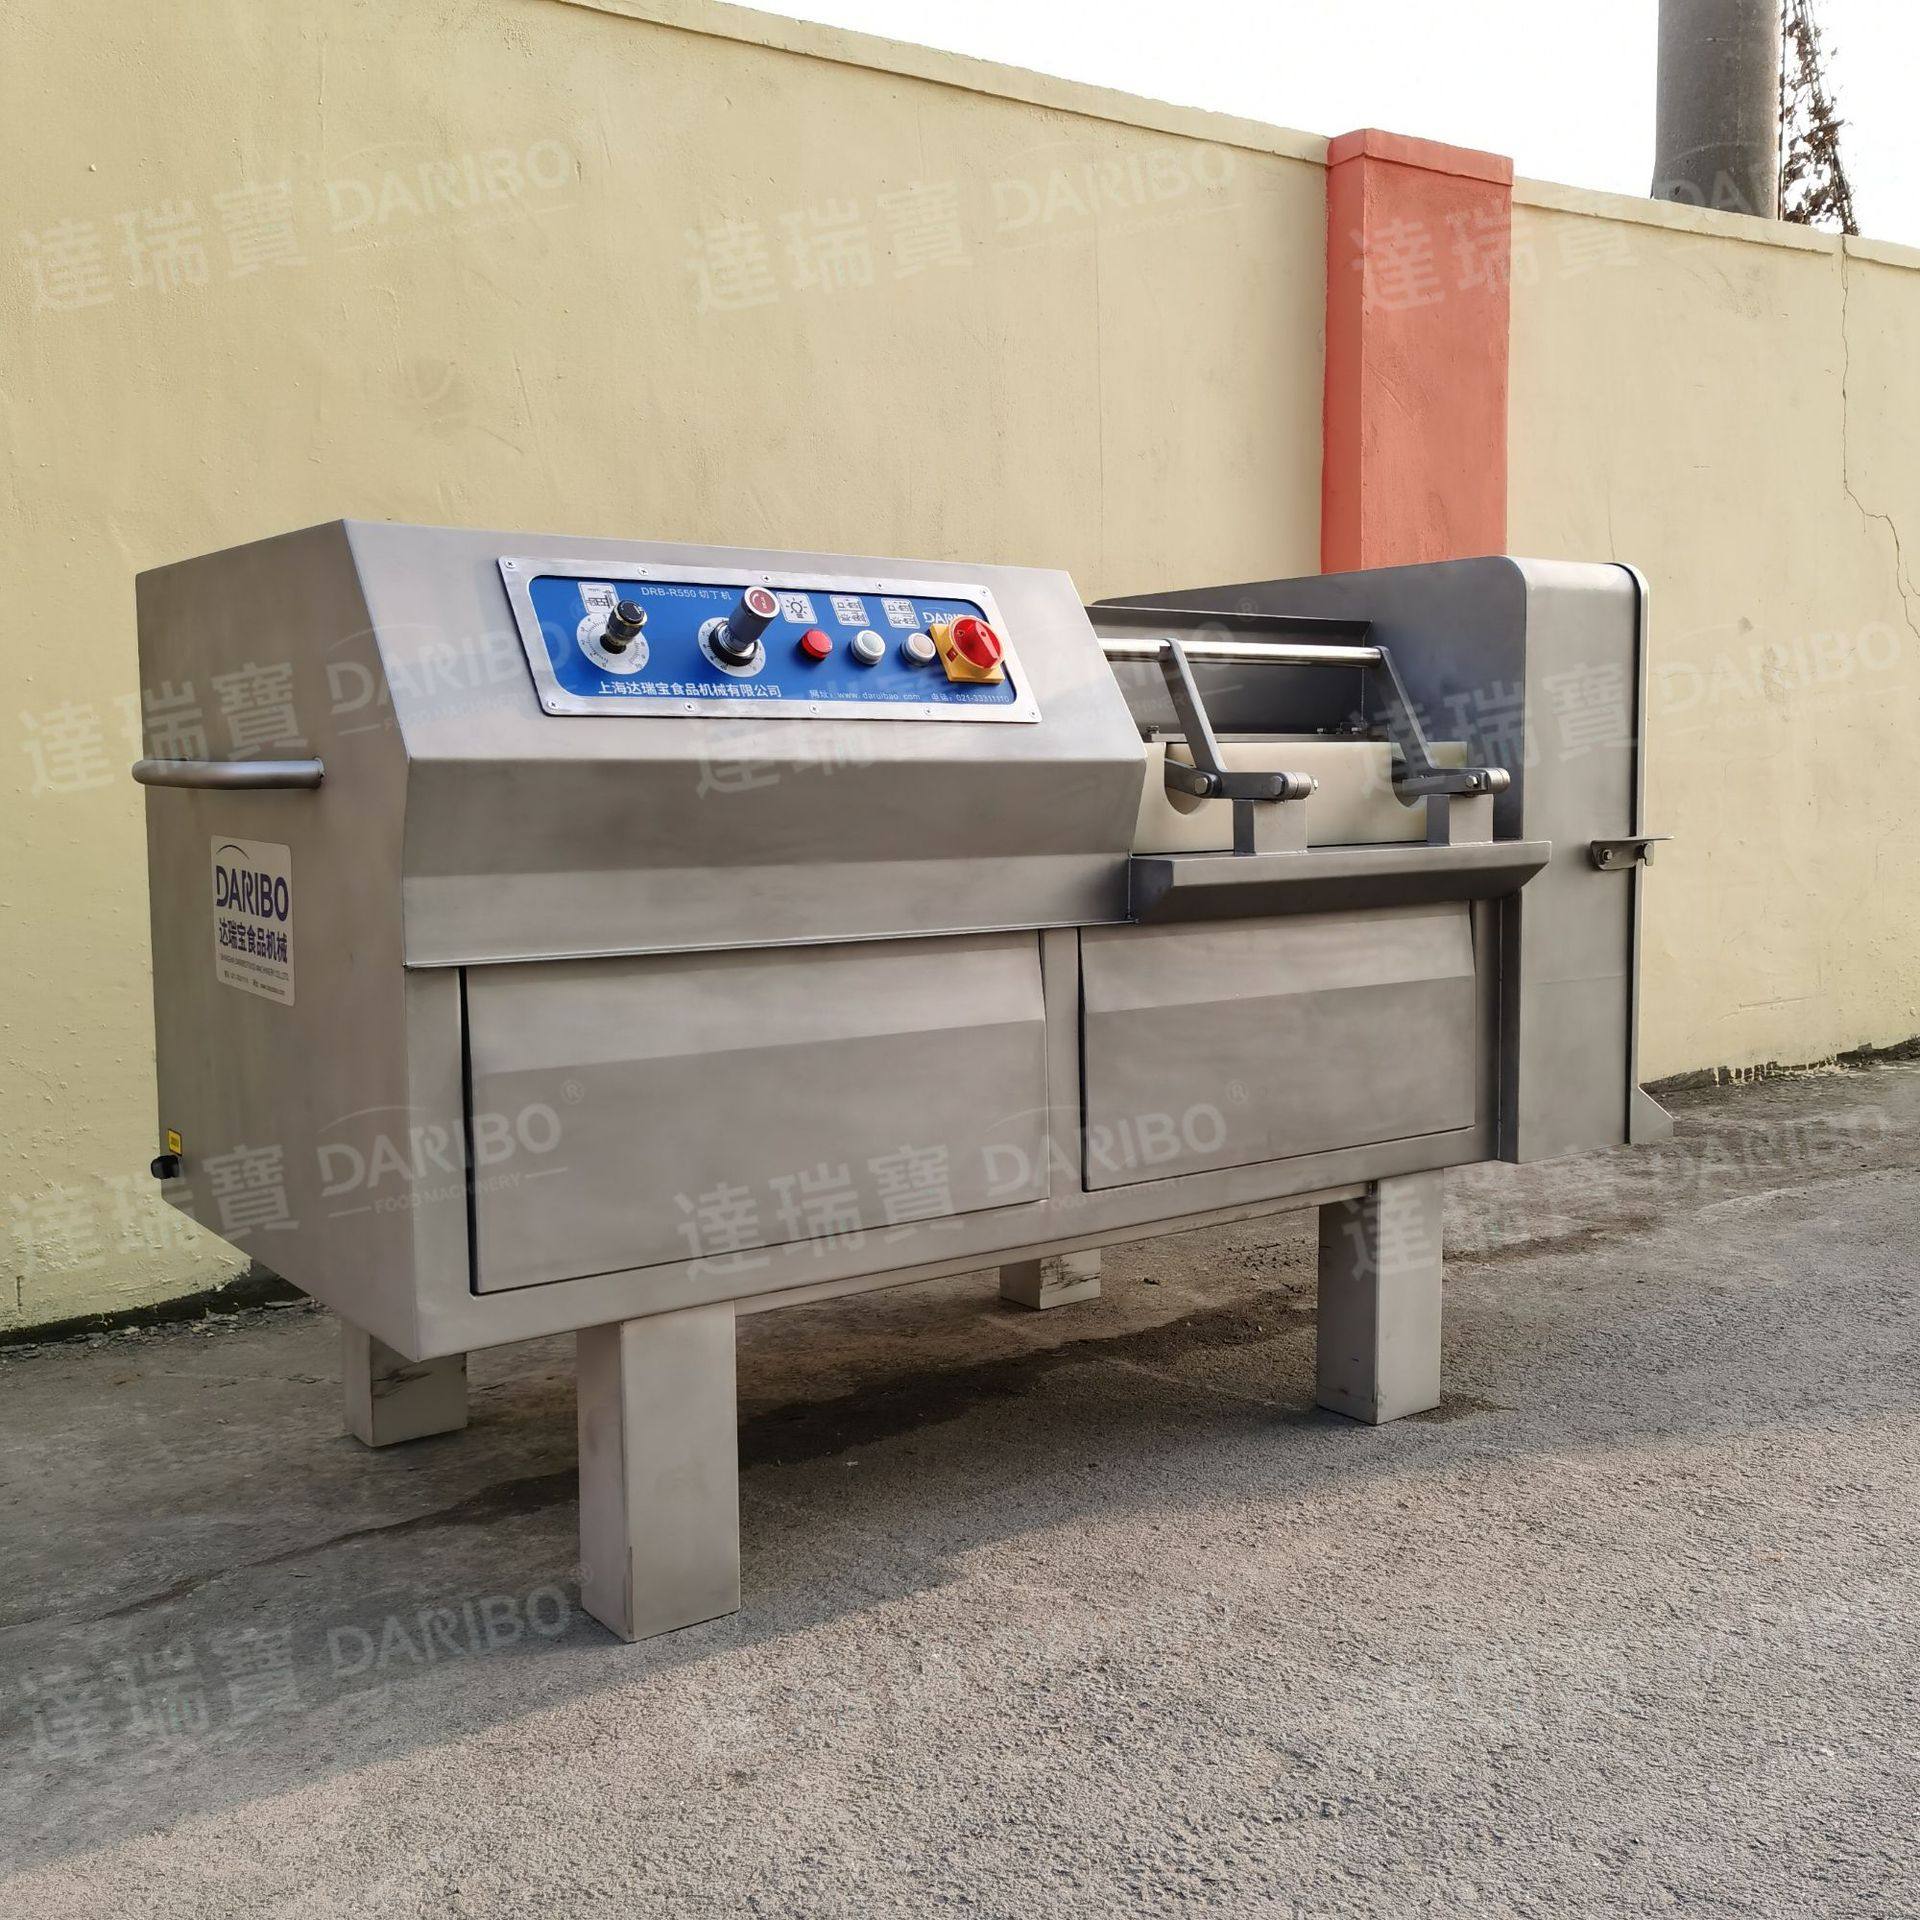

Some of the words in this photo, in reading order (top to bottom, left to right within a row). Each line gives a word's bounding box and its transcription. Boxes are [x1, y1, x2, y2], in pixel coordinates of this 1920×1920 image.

[598, 680, 782, 698] 上海达瑞宝食品机械有限公司
[215, 865, 289, 922] DARIBO
[218, 917, 288, 964] 达瑞宝食品机械
